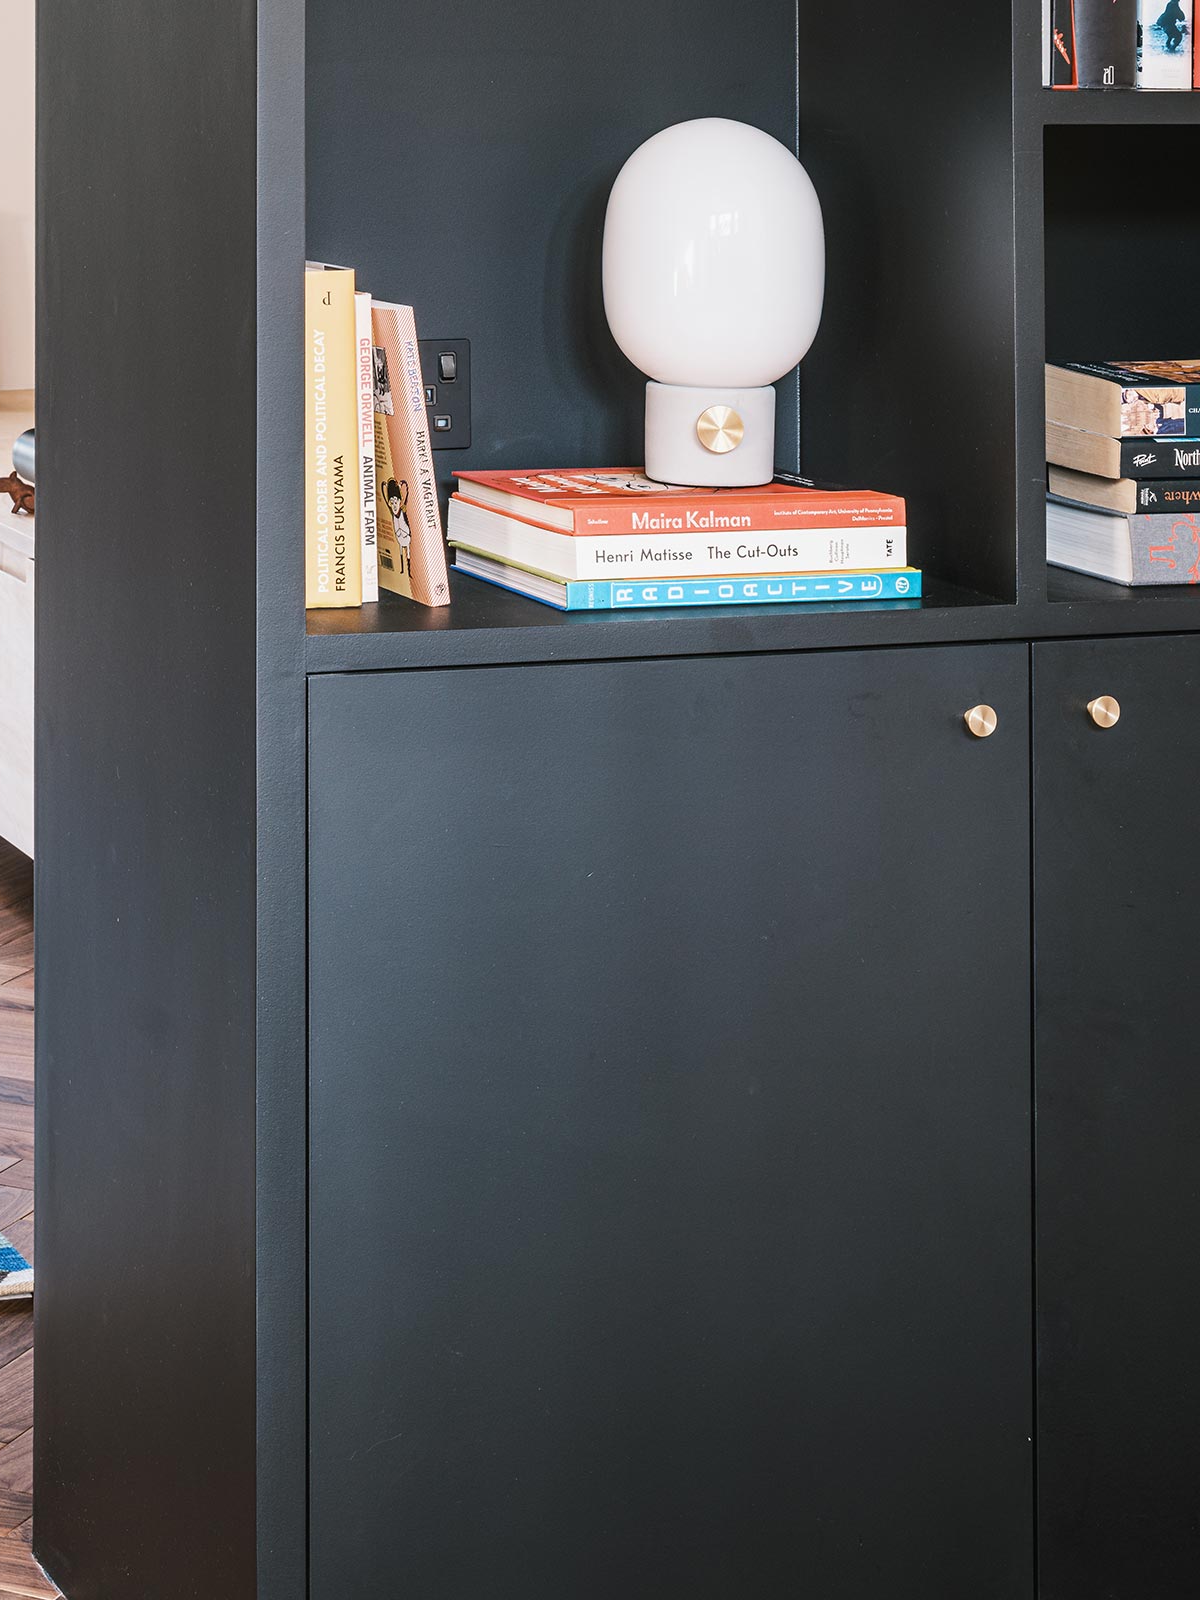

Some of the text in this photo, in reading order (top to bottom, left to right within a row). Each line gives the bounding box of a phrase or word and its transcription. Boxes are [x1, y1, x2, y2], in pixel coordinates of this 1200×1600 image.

[404, 340, 416, 368] KATE
[359, 337, 373, 448] GEORGE ORWELL
[313, 328, 330, 593] POLITICAL ORDER AND POLITICAL DECAY
[420, 466, 430, 476] A
[362, 455, 376, 546] ANIMAL FARM
[422, 478, 437, 530] VAGRANT
[333, 455, 346, 592] FRANCIS FUKUYAMA
[631, 510, 751, 530] Maira Kalman
[595, 548, 693, 563] Henri Matisse
[707, 543, 799, 560] The Cut-Outs
[616, 580, 877, 602] RADIOACTIVE
